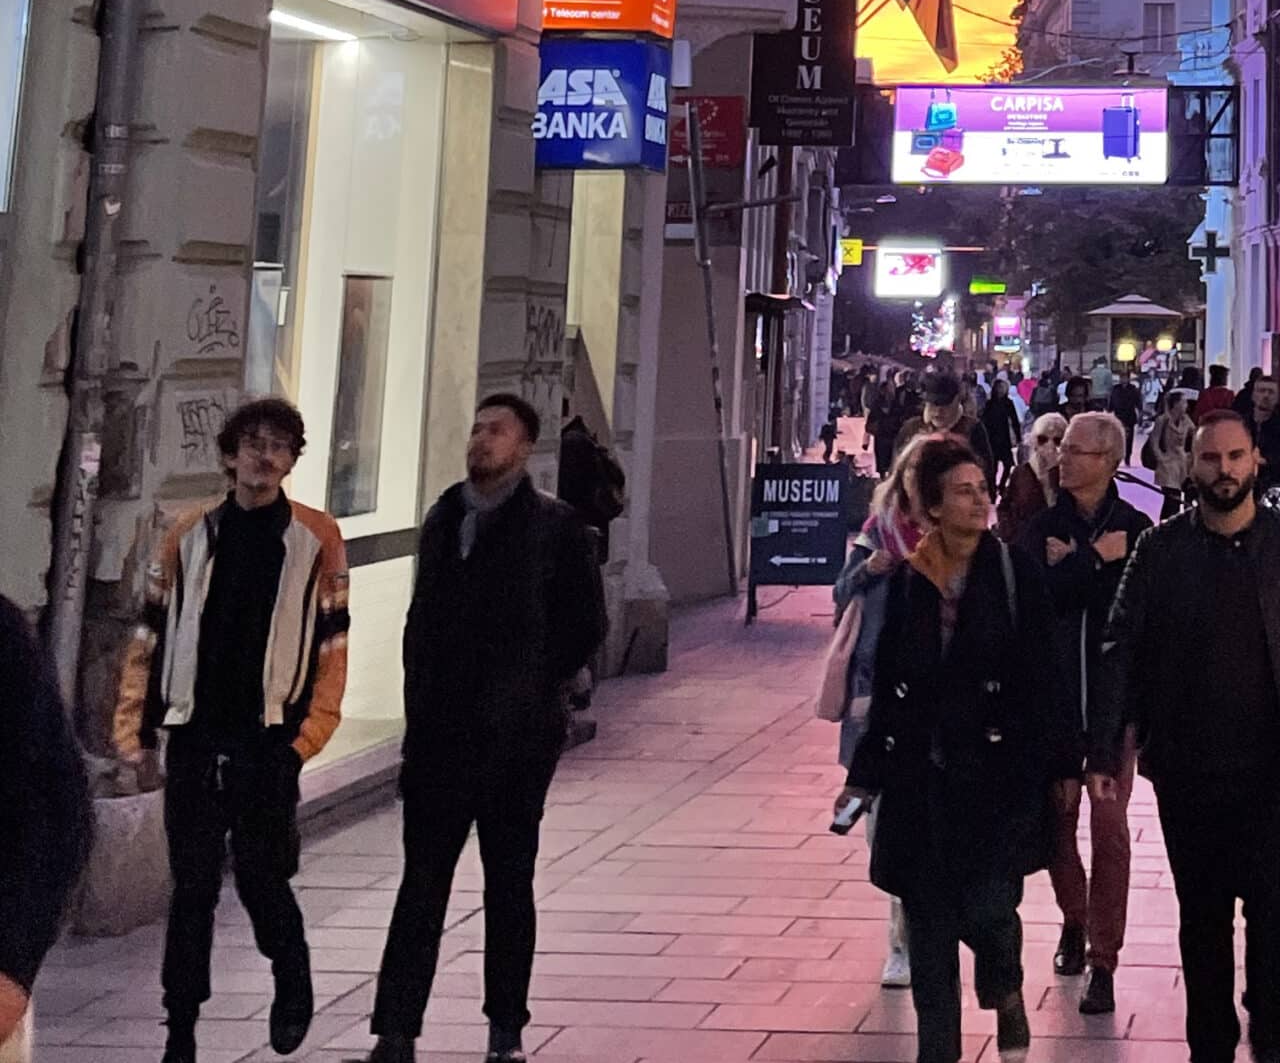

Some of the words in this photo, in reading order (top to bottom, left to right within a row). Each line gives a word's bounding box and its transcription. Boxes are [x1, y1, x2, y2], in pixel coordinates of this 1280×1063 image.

[537, 68, 629, 106] ASA
[990, 95, 1065, 113] CARPISA
[531, 111, 629, 139] BANKA
[763, 479, 840, 503] MUSEUM
